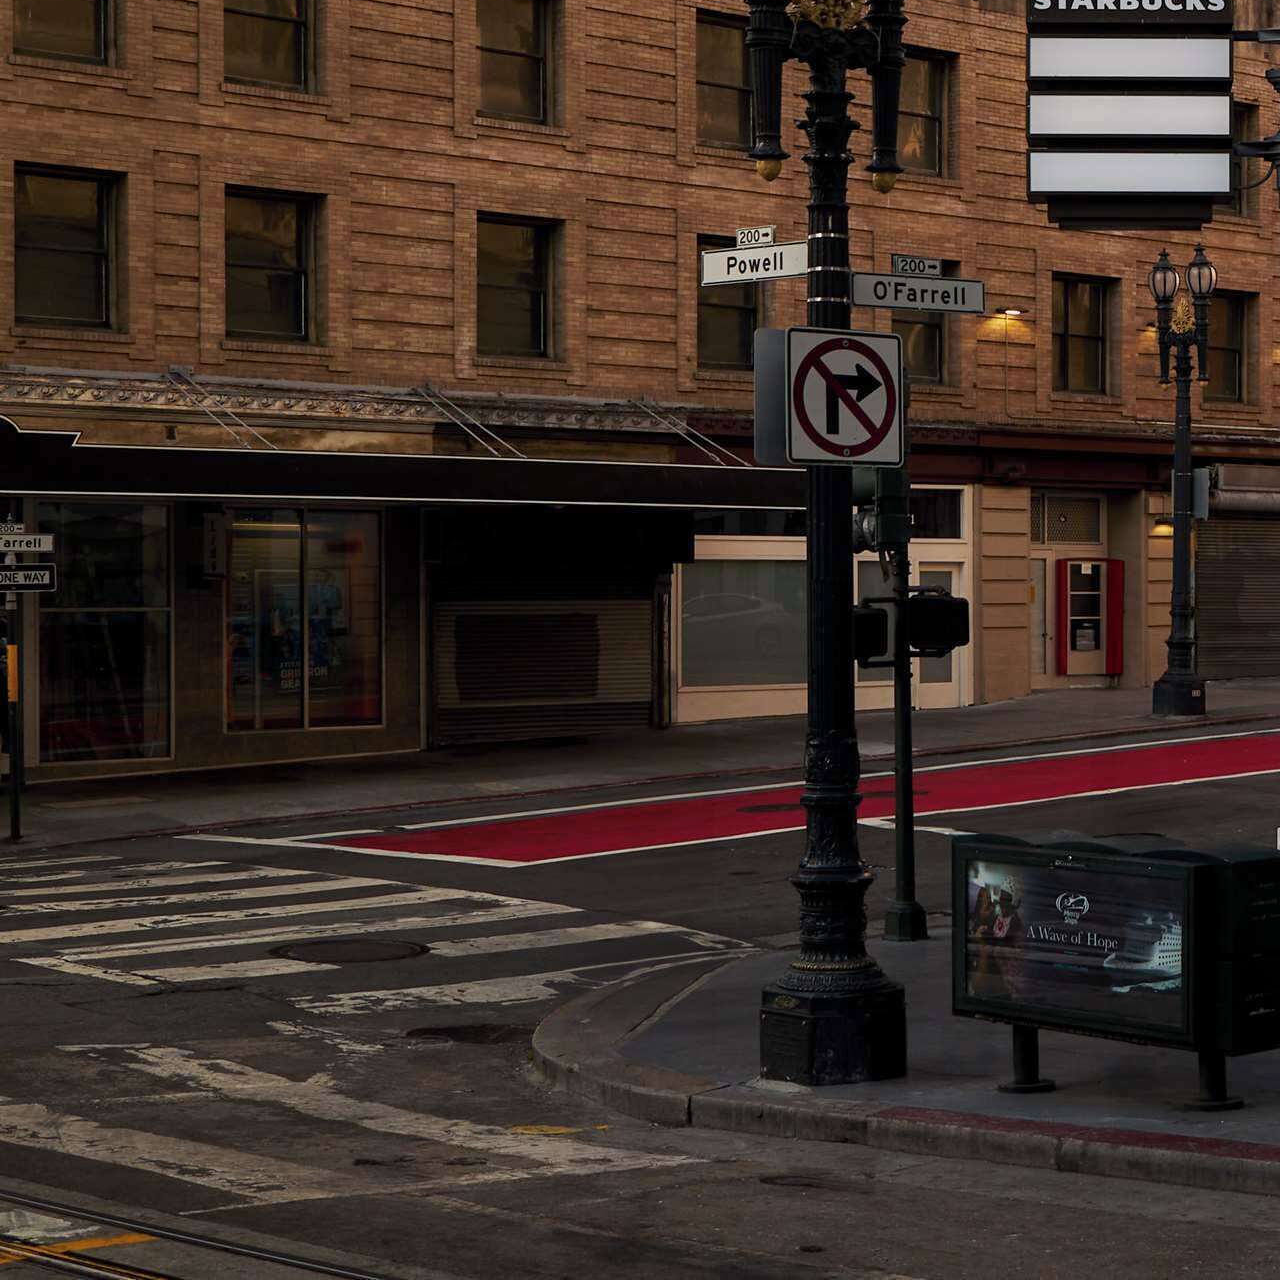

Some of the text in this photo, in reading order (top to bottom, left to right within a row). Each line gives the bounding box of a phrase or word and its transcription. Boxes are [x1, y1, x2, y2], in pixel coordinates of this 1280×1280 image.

[739, 229, 760, 243] 200
[727, 251, 783, 275] Powell
[900, 259, 926, 272] 200
[873, 281, 966, 305] O'Farrell
[23, 572, 47, 583] WAY
[1026, 925, 1119, 952] A Wave of Hope
